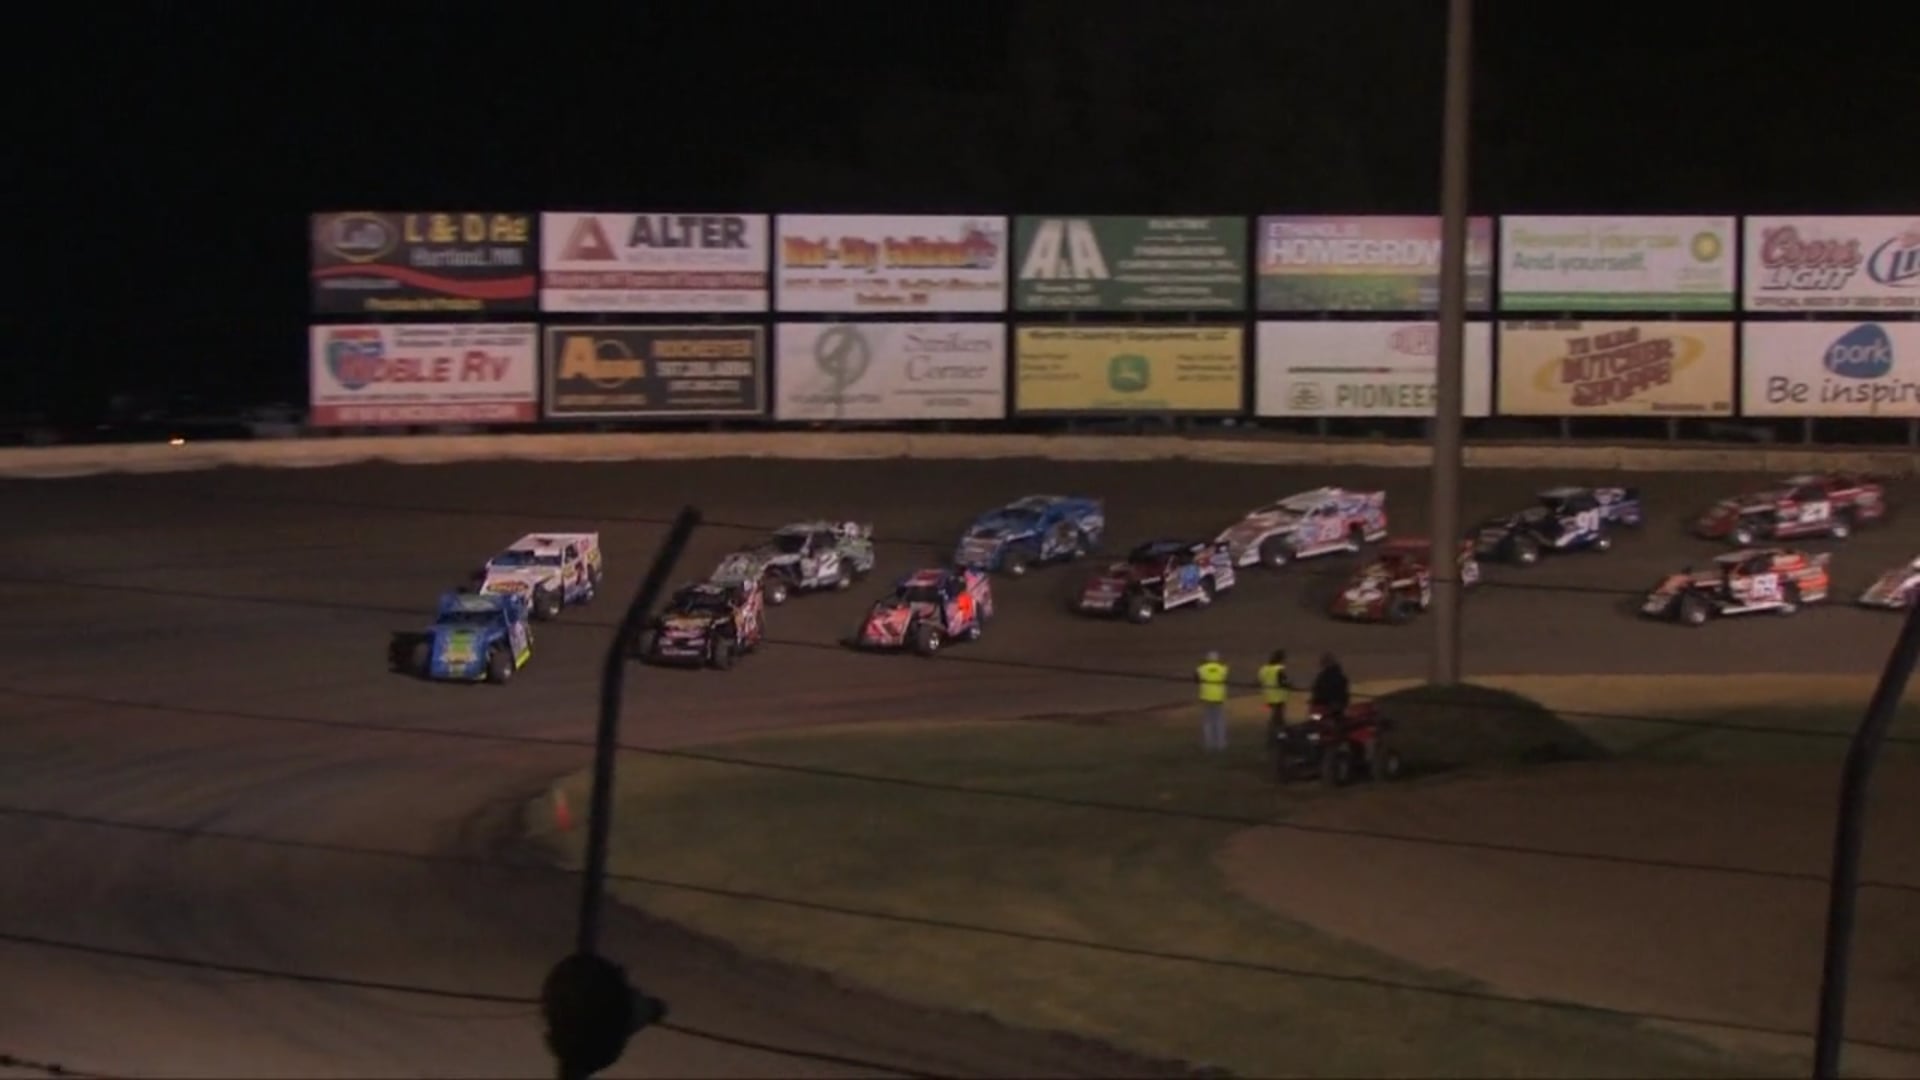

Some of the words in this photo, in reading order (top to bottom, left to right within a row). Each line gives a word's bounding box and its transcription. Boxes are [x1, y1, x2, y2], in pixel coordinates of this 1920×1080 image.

[626, 215, 749, 248] ALTER
[1761, 225, 1863, 268] Coors
[1513, 252, 1555, 270] And
[1760, 266, 1857, 290] LIGHT
[1832, 338, 1892, 370] pork
[1767, 376, 1809, 404] Be
